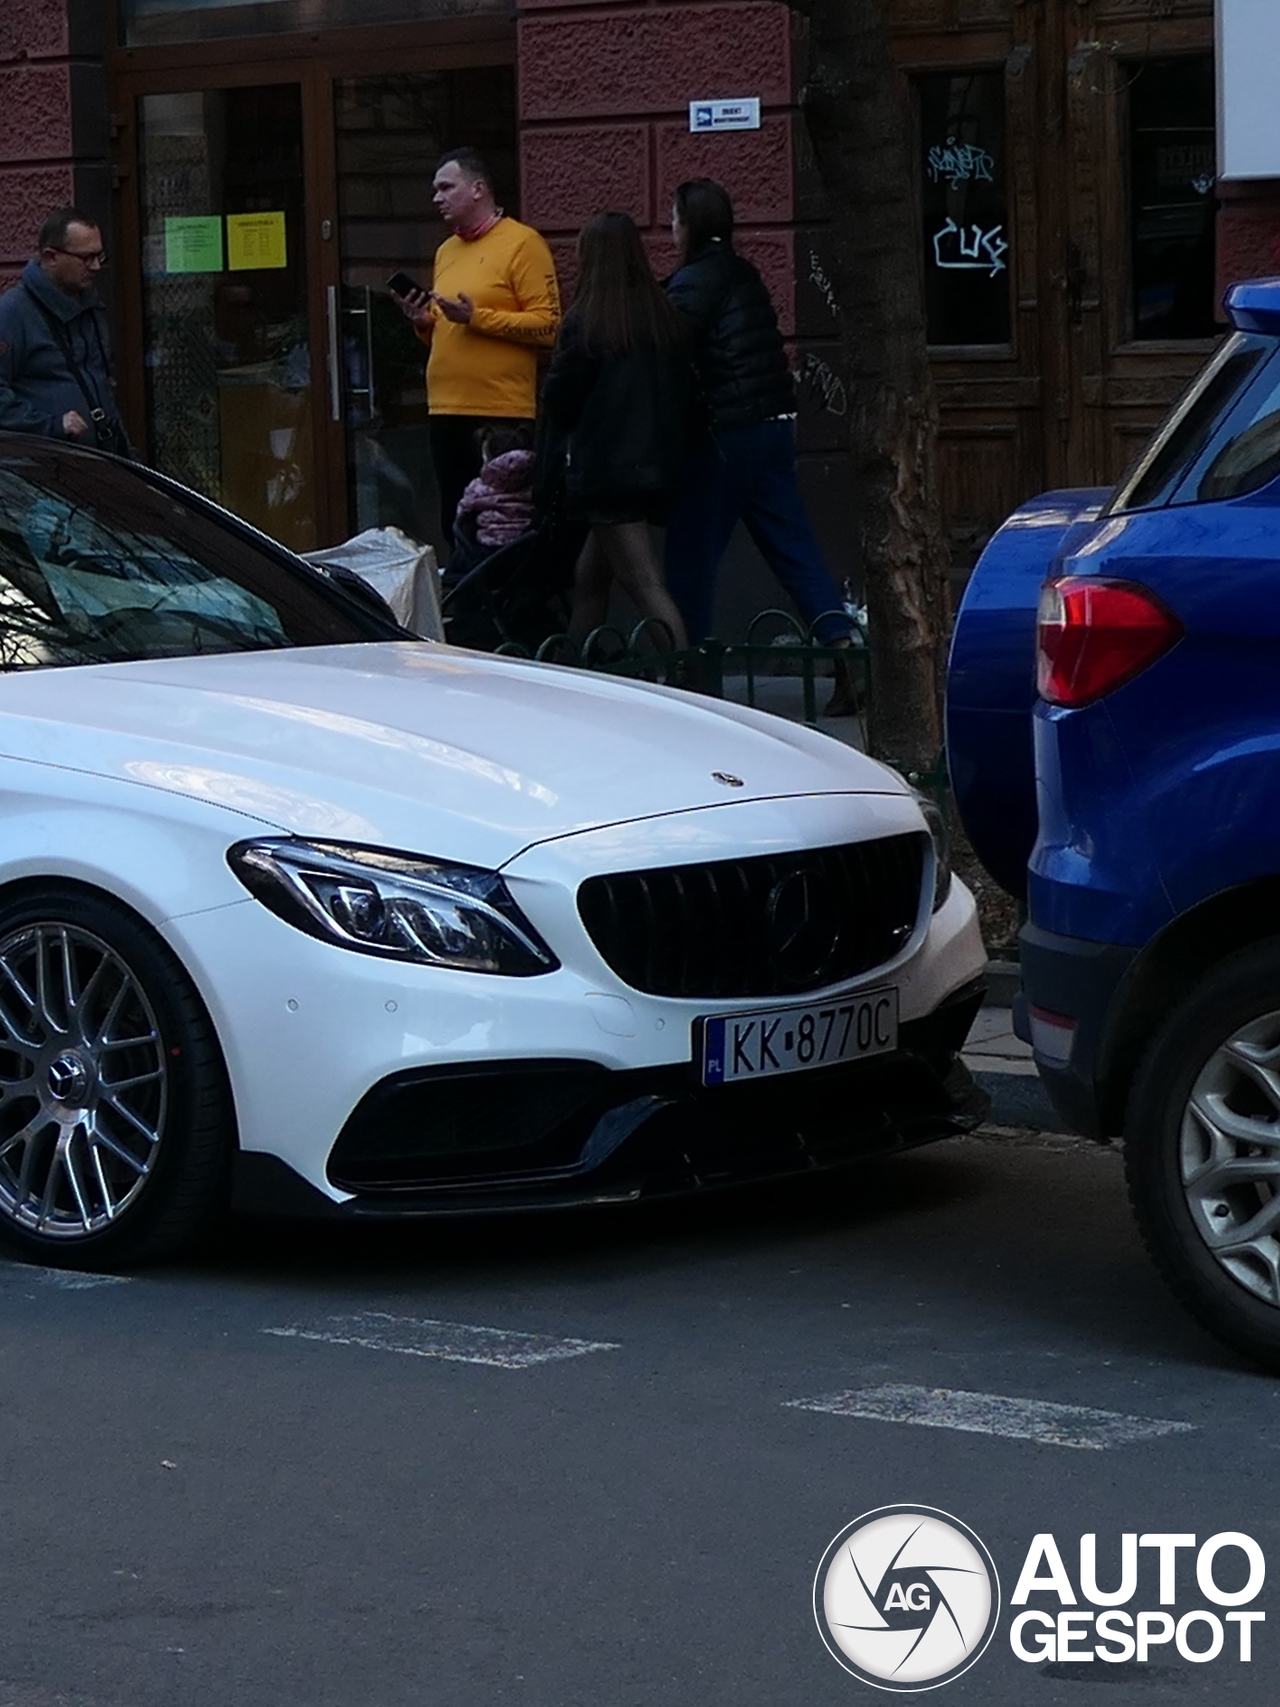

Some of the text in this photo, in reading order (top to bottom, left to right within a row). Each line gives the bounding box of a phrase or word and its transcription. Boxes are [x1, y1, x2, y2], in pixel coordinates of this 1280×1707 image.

[733, 998, 890, 1074] KK 8770C
[708, 1059, 721, 1073] PL
